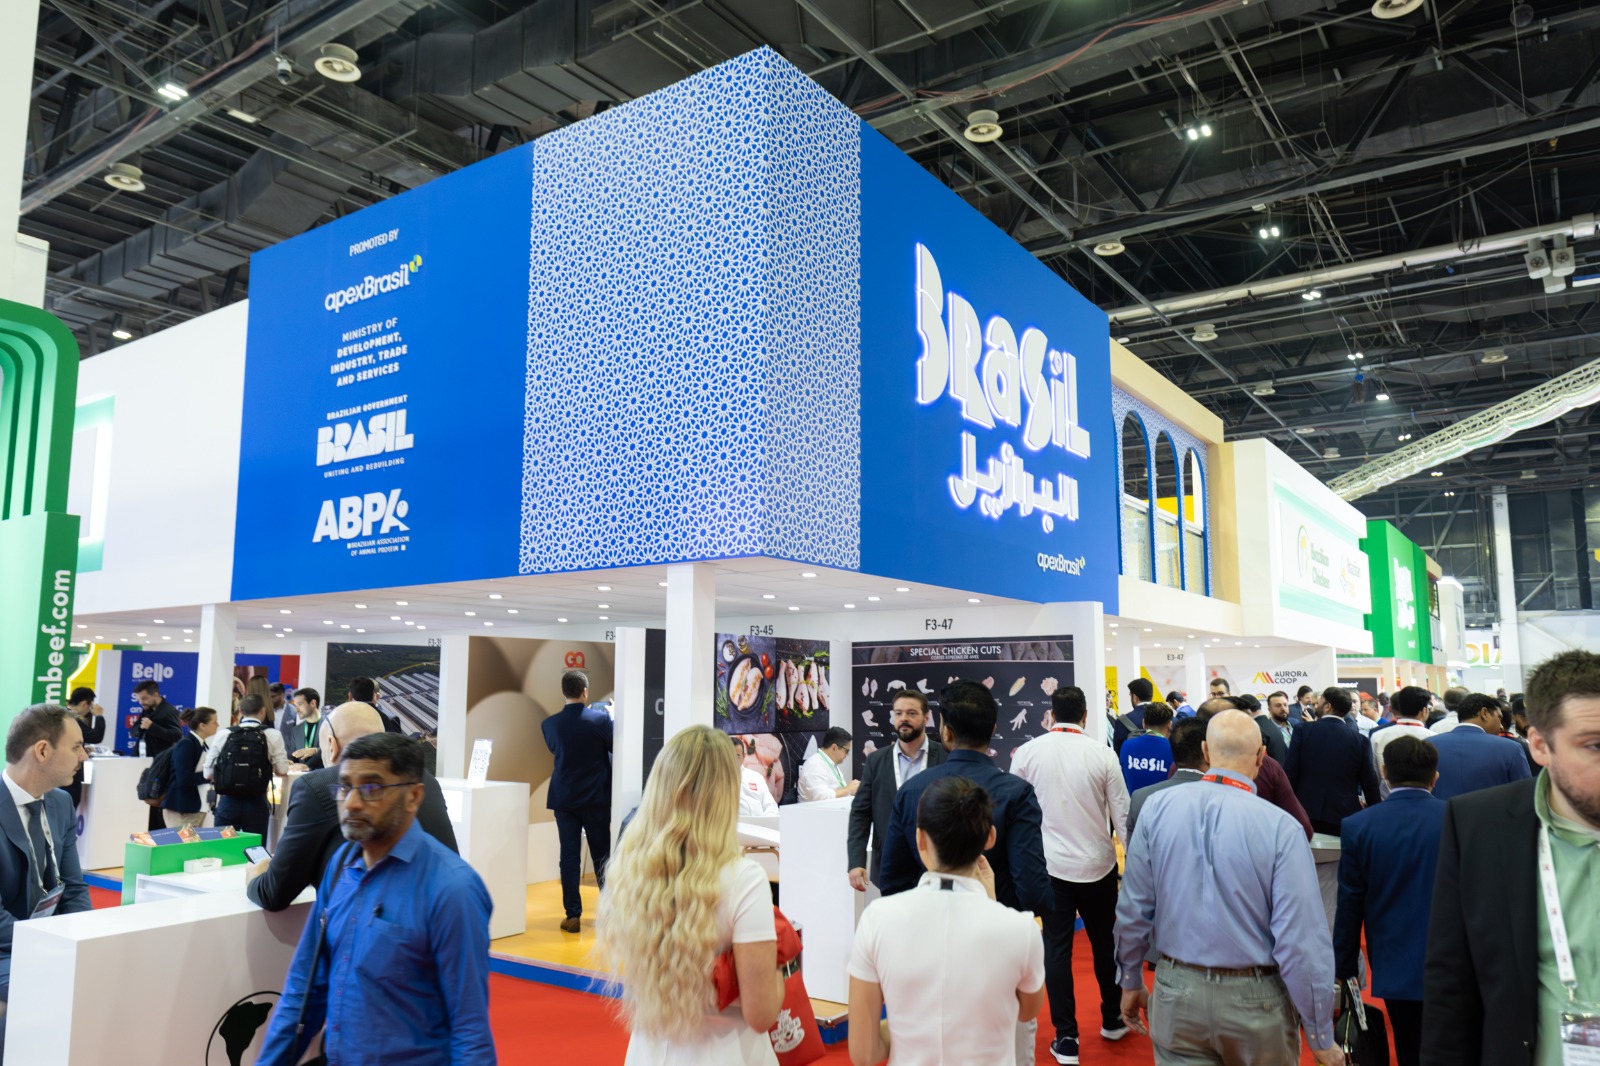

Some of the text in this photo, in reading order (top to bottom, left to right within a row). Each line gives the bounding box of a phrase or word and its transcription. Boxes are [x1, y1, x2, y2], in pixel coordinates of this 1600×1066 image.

[350, 228, 399, 256] PROMOTED BY
[324, 263, 410, 313] apexBrasil
[342, 317, 398, 342] MINISTRY OF
[337, 332, 402, 358] DEVELOPMENT,
[330, 345, 408, 374] INDUSTRY, TRADE
[337, 362, 400, 387] AND SERVICES
[327, 394, 408, 420] BRAZILIAN GOVERNMENT
[316, 408, 414, 467] BRASIL
[324, 457, 405, 478] UNITING AND REBUILDING
[1037, 552, 1080, 576] apexBrasil
[750, 625, 774, 636] F3-45
[925, 618, 953, 630] F3-47
[910, 646, 1002, 656] SPECIAL CHICKEN CUTS
[1167, 653, 1184, 661] E3-47
[132, 662, 174, 682] Bello
